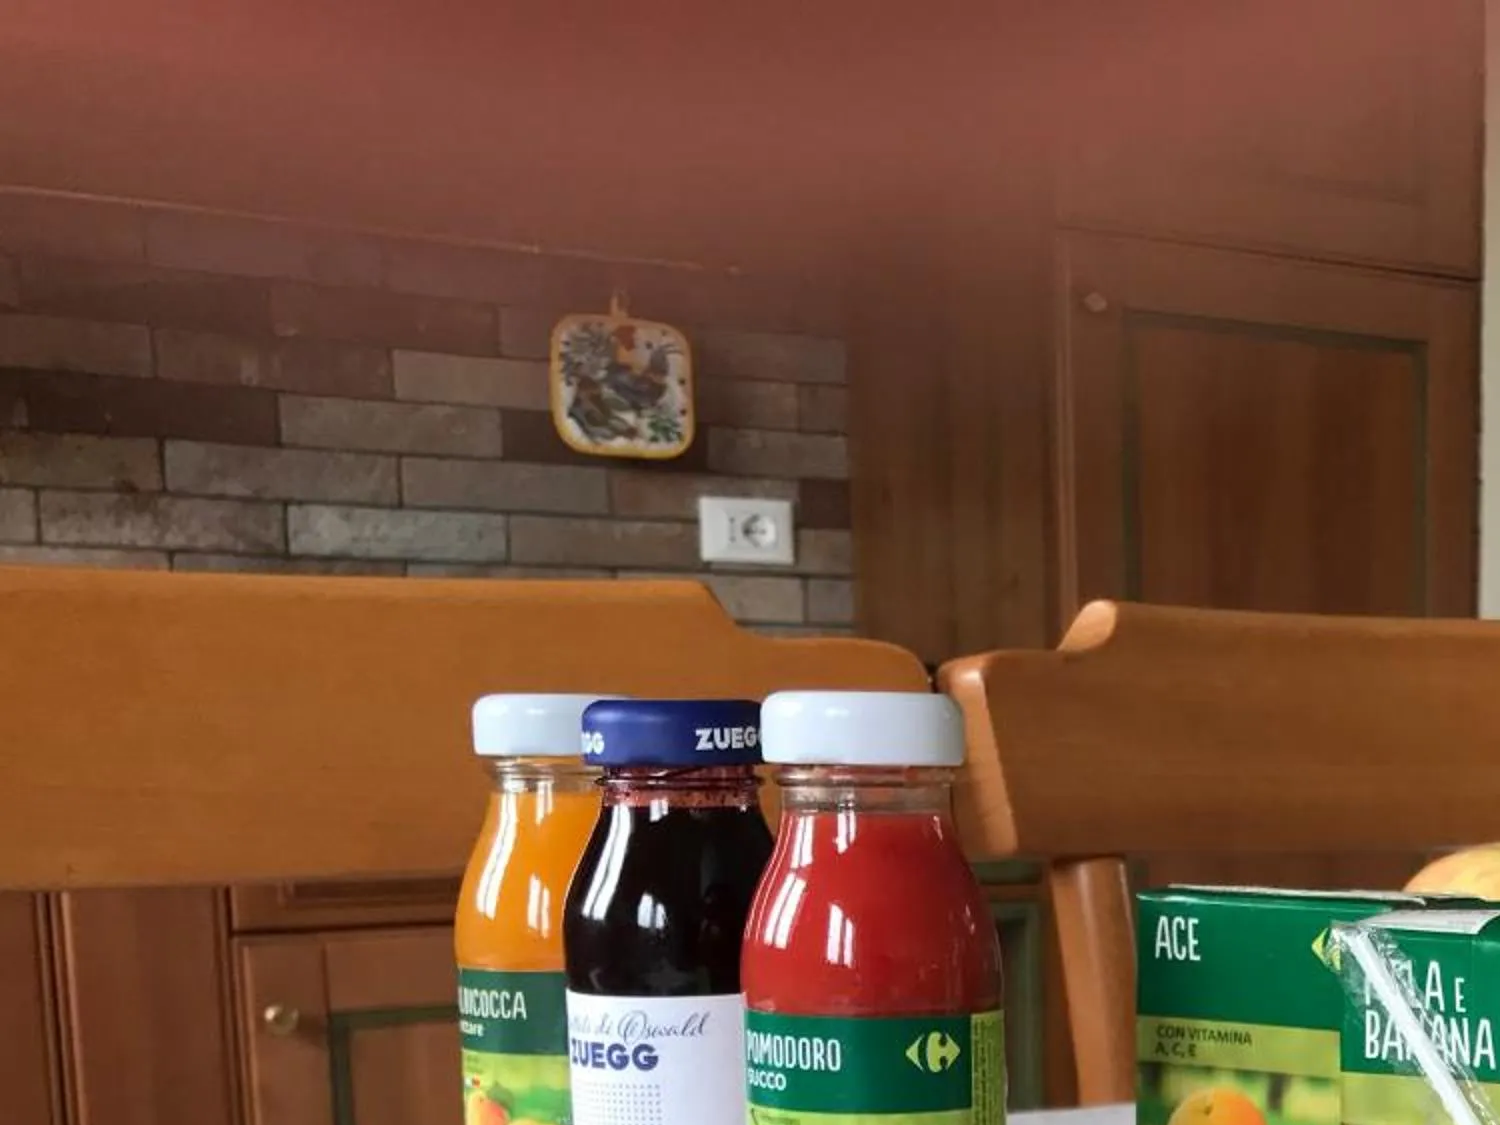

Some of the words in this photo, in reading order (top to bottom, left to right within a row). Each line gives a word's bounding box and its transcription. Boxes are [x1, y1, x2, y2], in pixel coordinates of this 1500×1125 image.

[696, 726, 763, 751] ZUEG
[1155, 915, 1201, 962] ACE
[1454, 977, 1467, 1013] E
[618, 1010, 711, 1045] Oswald
[1156, 1023, 1185, 1040] CON
[1187, 1026, 1252, 1047] VITAMINA
[1365, 1009, 1497, 1070] BAANA
[571, 1038, 659, 1071] ZUEGG
[746, 1030, 841, 1072] POMODORO
[1188, 1043, 1197, 1058] E
[748, 1070, 787, 1091] SUCCO
